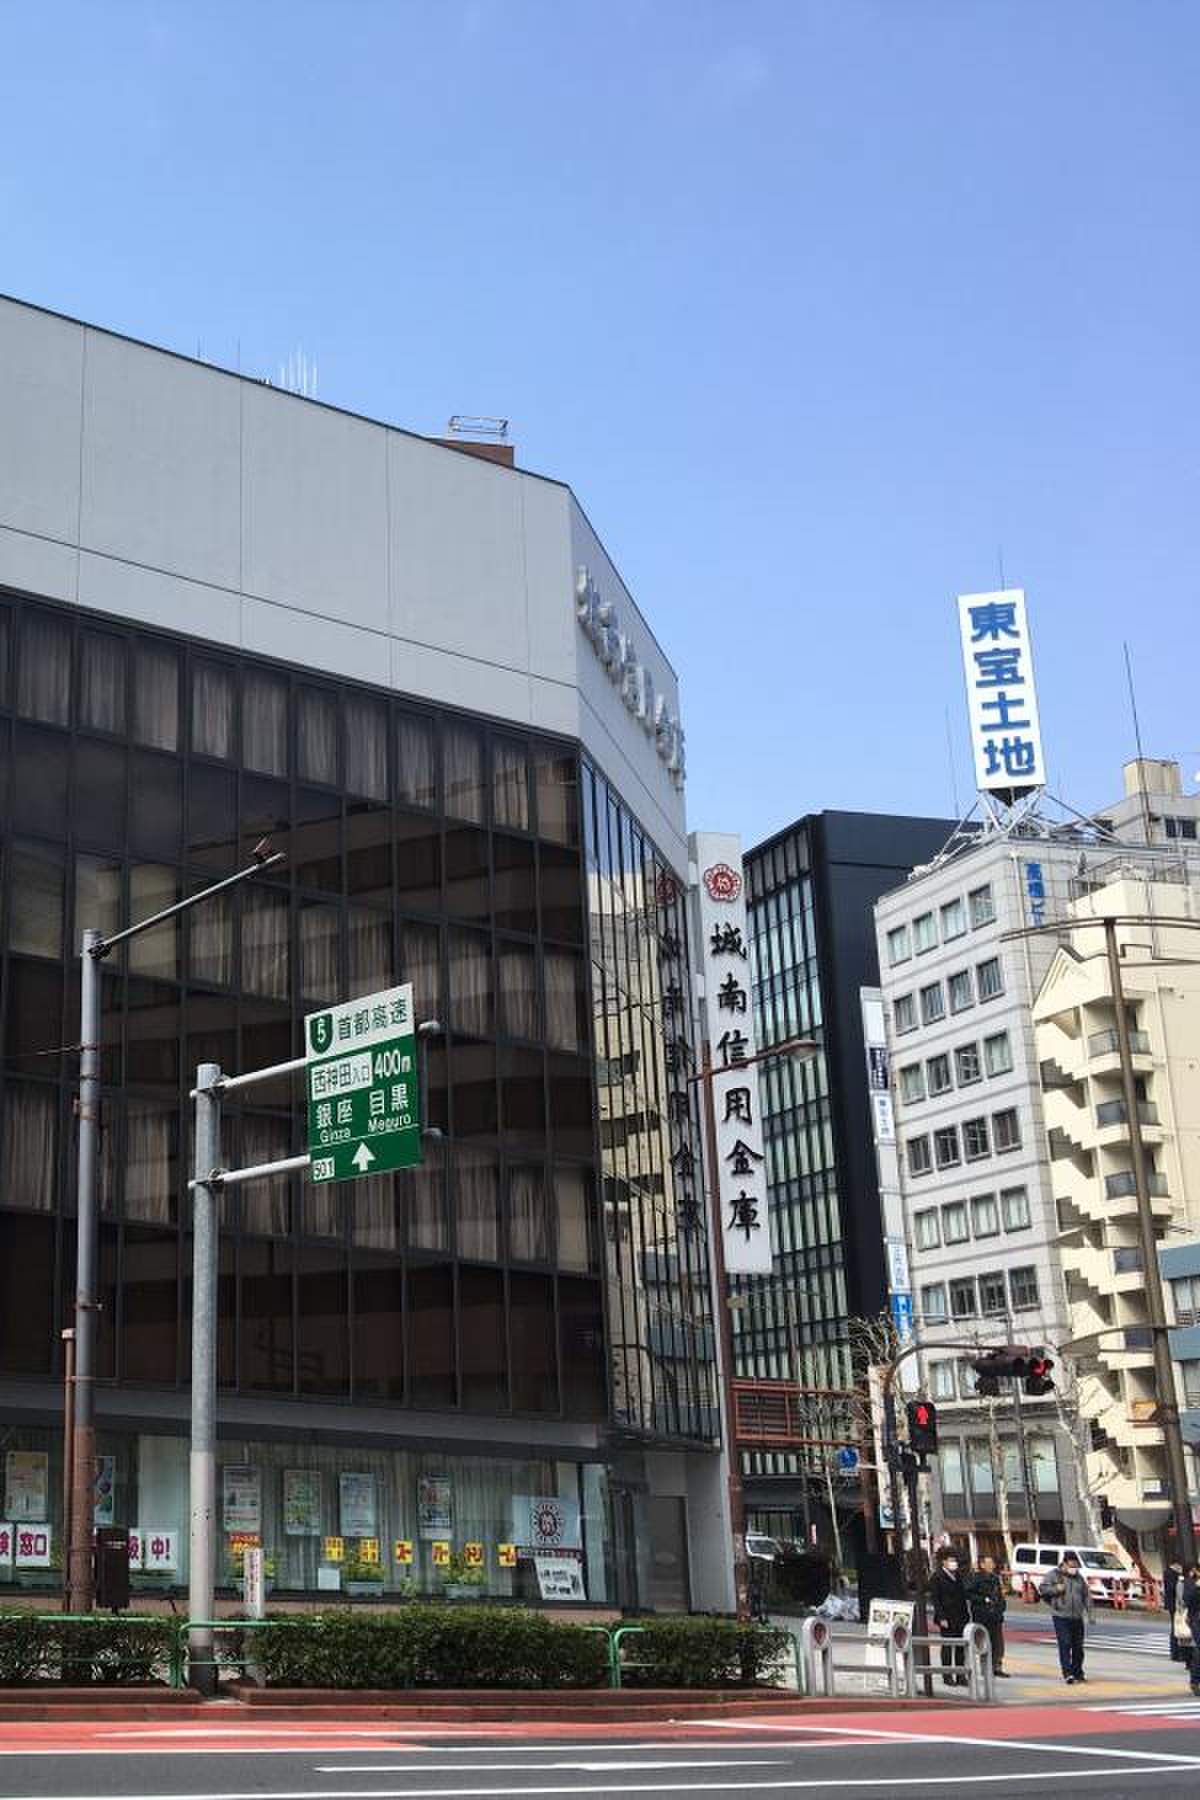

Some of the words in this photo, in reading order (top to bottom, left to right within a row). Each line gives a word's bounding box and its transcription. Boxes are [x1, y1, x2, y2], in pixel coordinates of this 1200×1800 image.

[968, 601, 1036, 777] 東宝土地
[317, 1018, 327, 1043] 5
[338, 997, 408, 1041] 首都高速
[314, 1062, 369, 1094] 西神田入口
[711, 921, 764, 1242] 城南信用金庫
[316, 1099, 352, 1130] 銀座
[369, 1082, 410, 1117] 目黒
[320, 1127, 351, 1143] Ginza
[367, 1113, 411, 1133] Meguro
